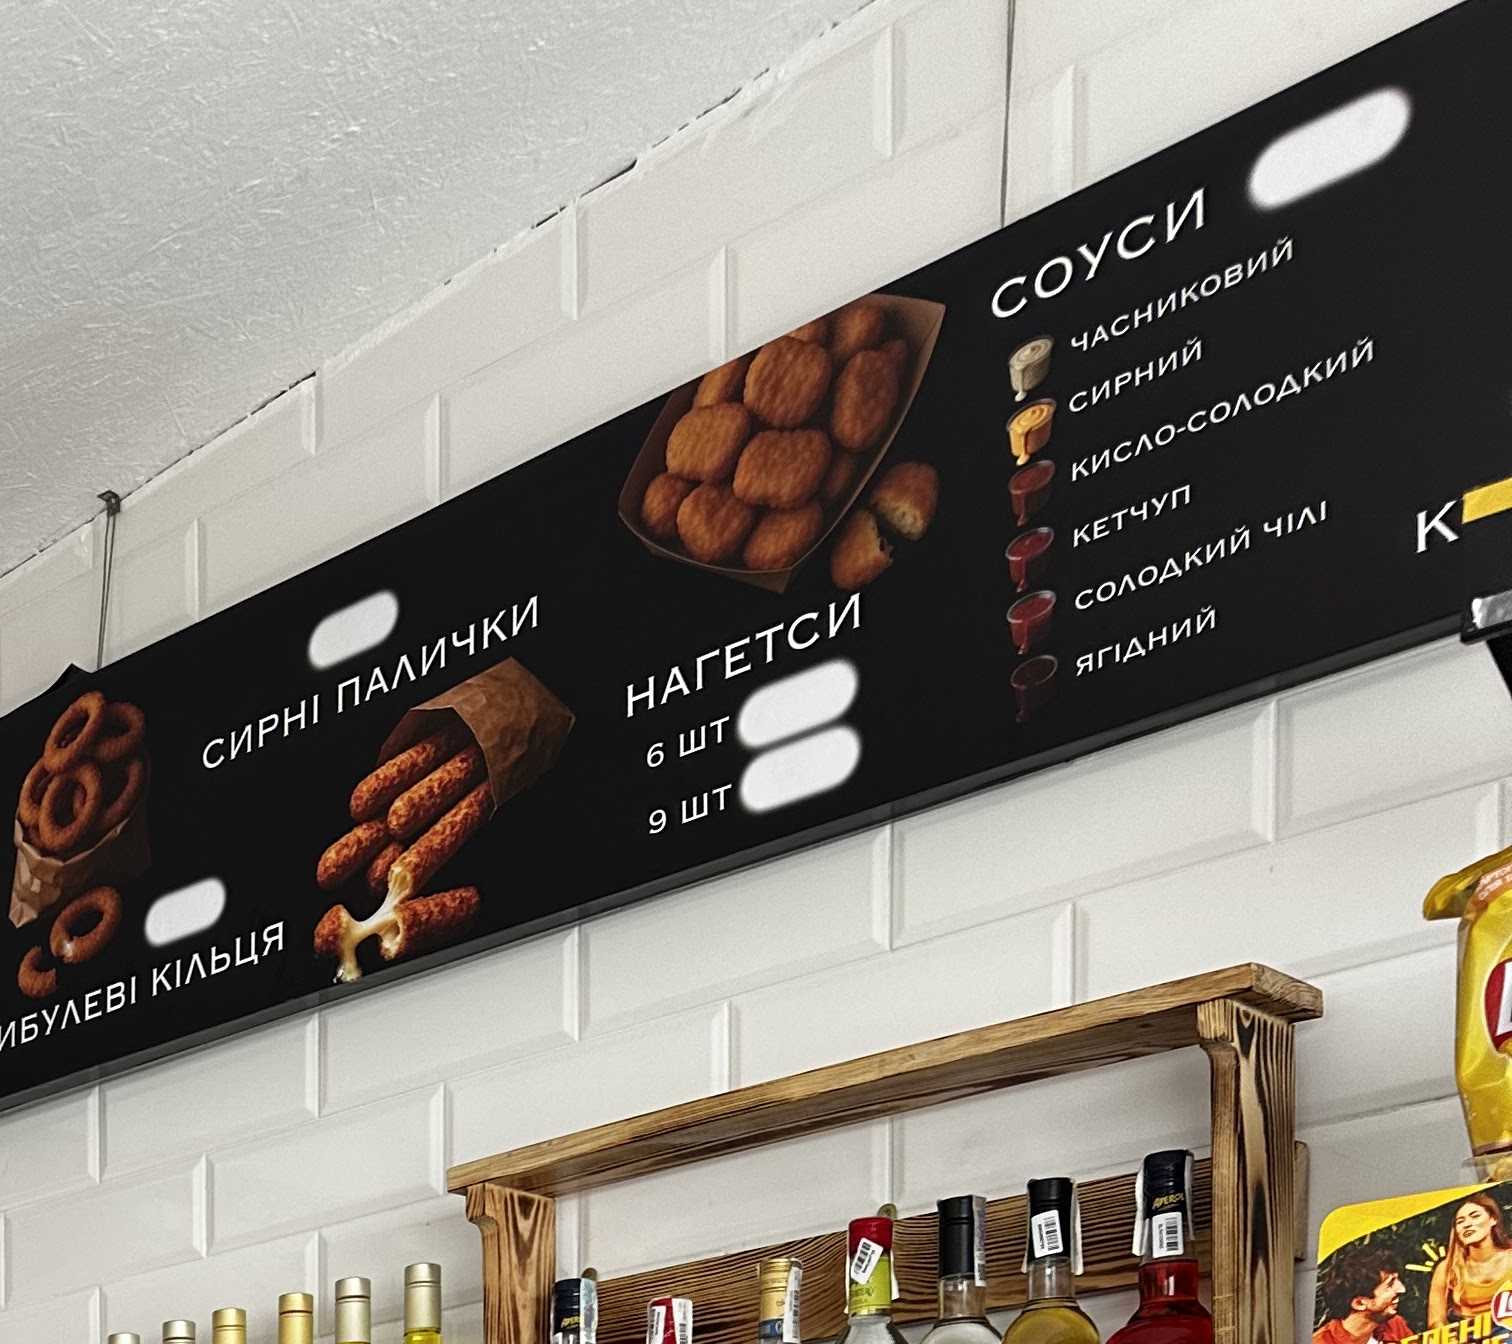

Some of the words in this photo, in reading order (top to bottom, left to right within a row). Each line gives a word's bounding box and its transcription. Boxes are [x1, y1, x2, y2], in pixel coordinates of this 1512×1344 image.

[990, 188, 1206, 319] СОУСИ
[1070, 235, 1294, 352] ЧАСНИКОВИЙ
[1068, 337, 1204, 413] СИРНИЙ
[1070, 336, 1375, 482] КИСЛО-СОЛОДКИЙ
[1072, 483, 1191, 548] КЕТЧУП
[1074, 527, 1251, 611] СОЛОДКИЙ
[1263, 500, 1328, 542] ЧІЛІ
[201, 692, 320, 771] СИРНІ
[336, 595, 539, 706] ПАЛИЧКИ
[625, 592, 862, 719] НАГЕТСИ
[1076, 605, 1217, 677] ЯГІДНИЙ
[645, 742, 666, 769] 6
[678, 716, 730, 758] ШТ
[647, 808, 668, 836] 9
[680, 783, 732, 824] ШТ
[150, 920, 285, 997] КІЛЬЦЯ
